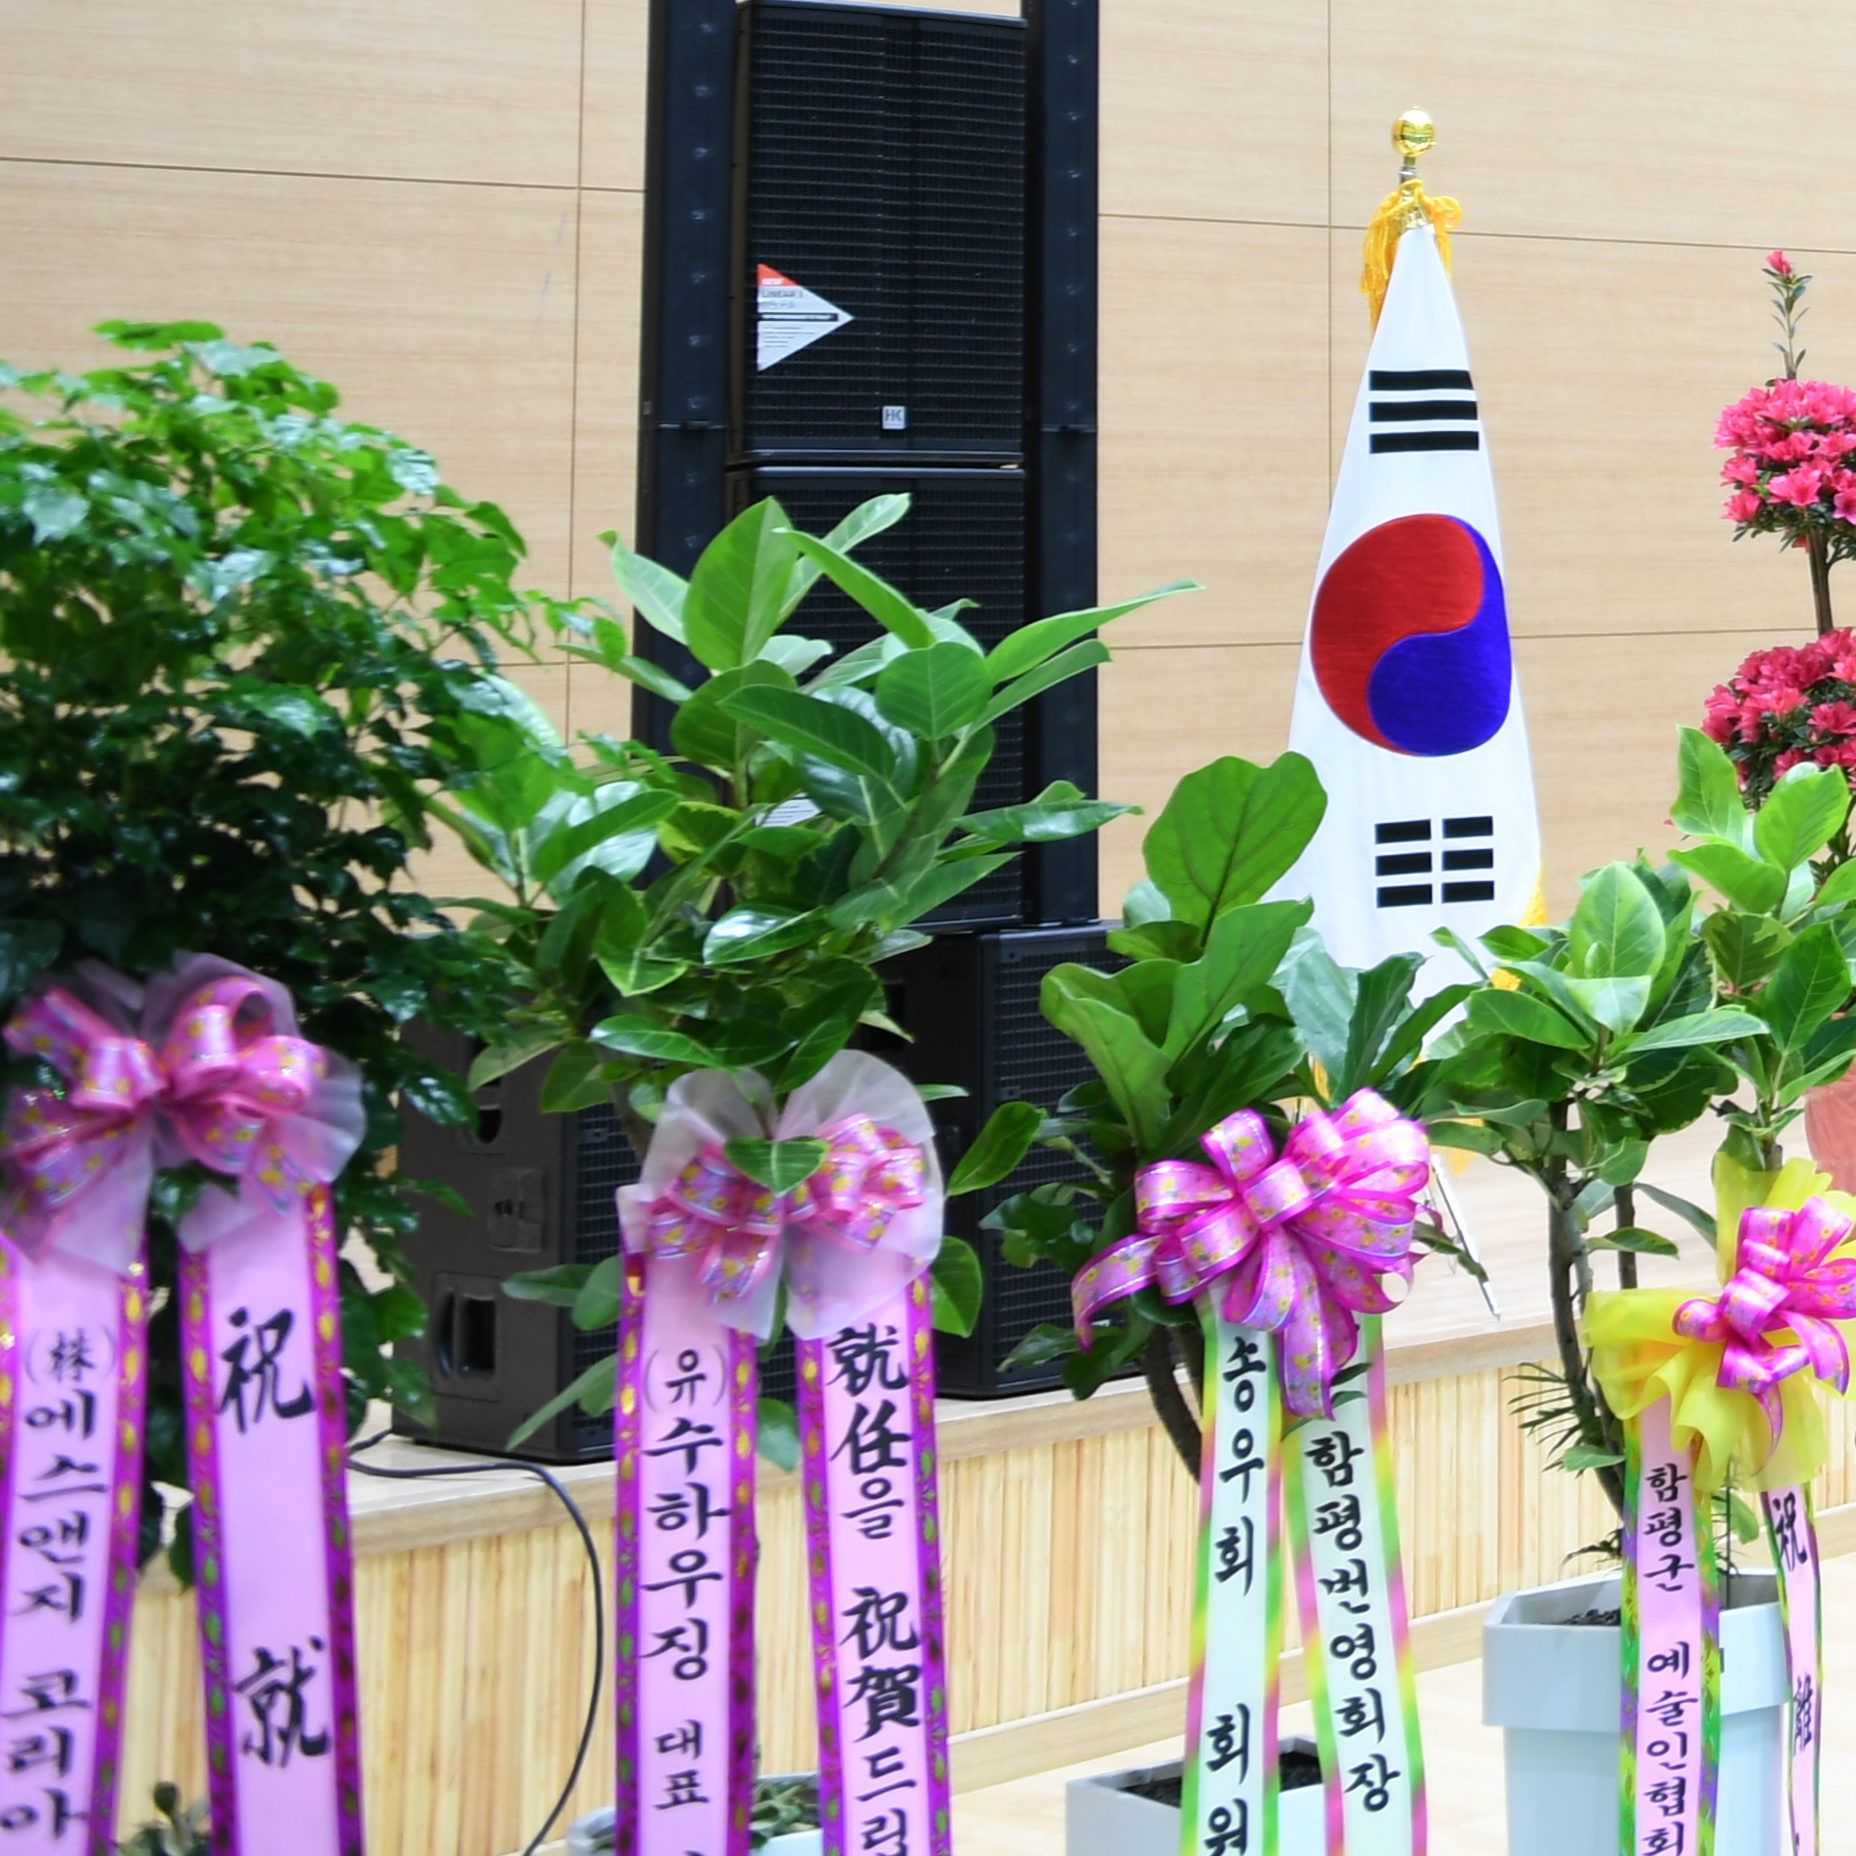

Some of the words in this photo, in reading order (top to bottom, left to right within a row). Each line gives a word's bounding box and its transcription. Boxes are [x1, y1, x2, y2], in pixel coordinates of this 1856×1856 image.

[826, 1322, 913, 1540] 就任을
[1213, 1335, 1267, 1598] 송우회
[1642, 1462, 1697, 1593] 함평군
[1303, 1430, 1401, 1813] 함평번영회장
[0, 1669, 92, 1839] 코리아
[653, 1719, 711, 1811] 대표
[1642, 1641, 1699, 1855] 예술인협회
